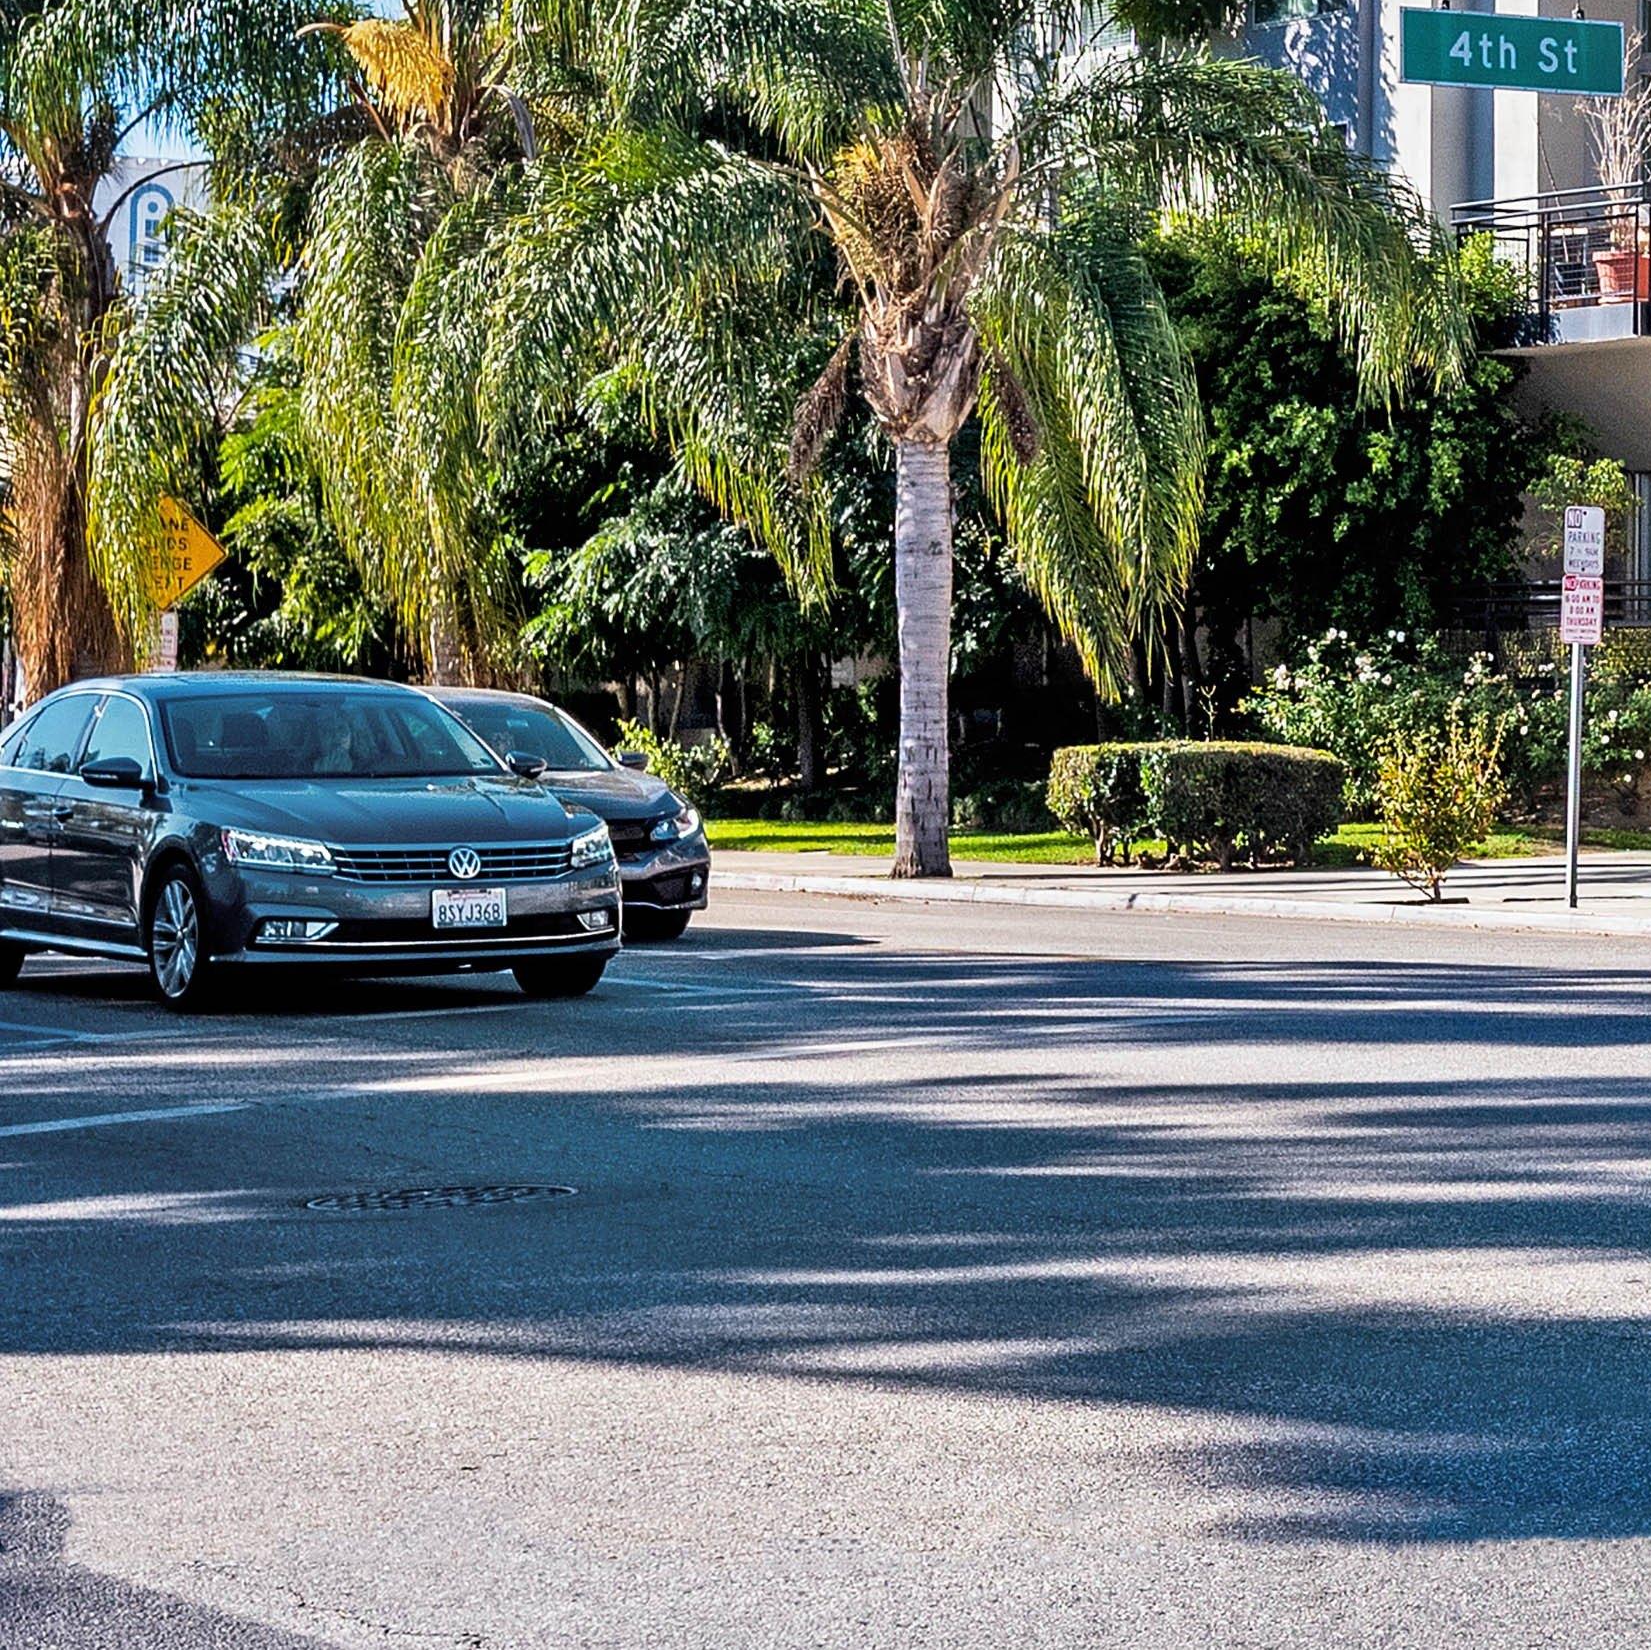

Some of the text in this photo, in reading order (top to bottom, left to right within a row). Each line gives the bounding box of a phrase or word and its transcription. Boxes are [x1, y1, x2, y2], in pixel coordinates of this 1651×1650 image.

[1449, 30, 1577, 74] 4th St
[1568, 509, 1581, 527] NO
[1568, 531, 1601, 544] PARKING
[438, 902, 501, 923] 8SYJ368
